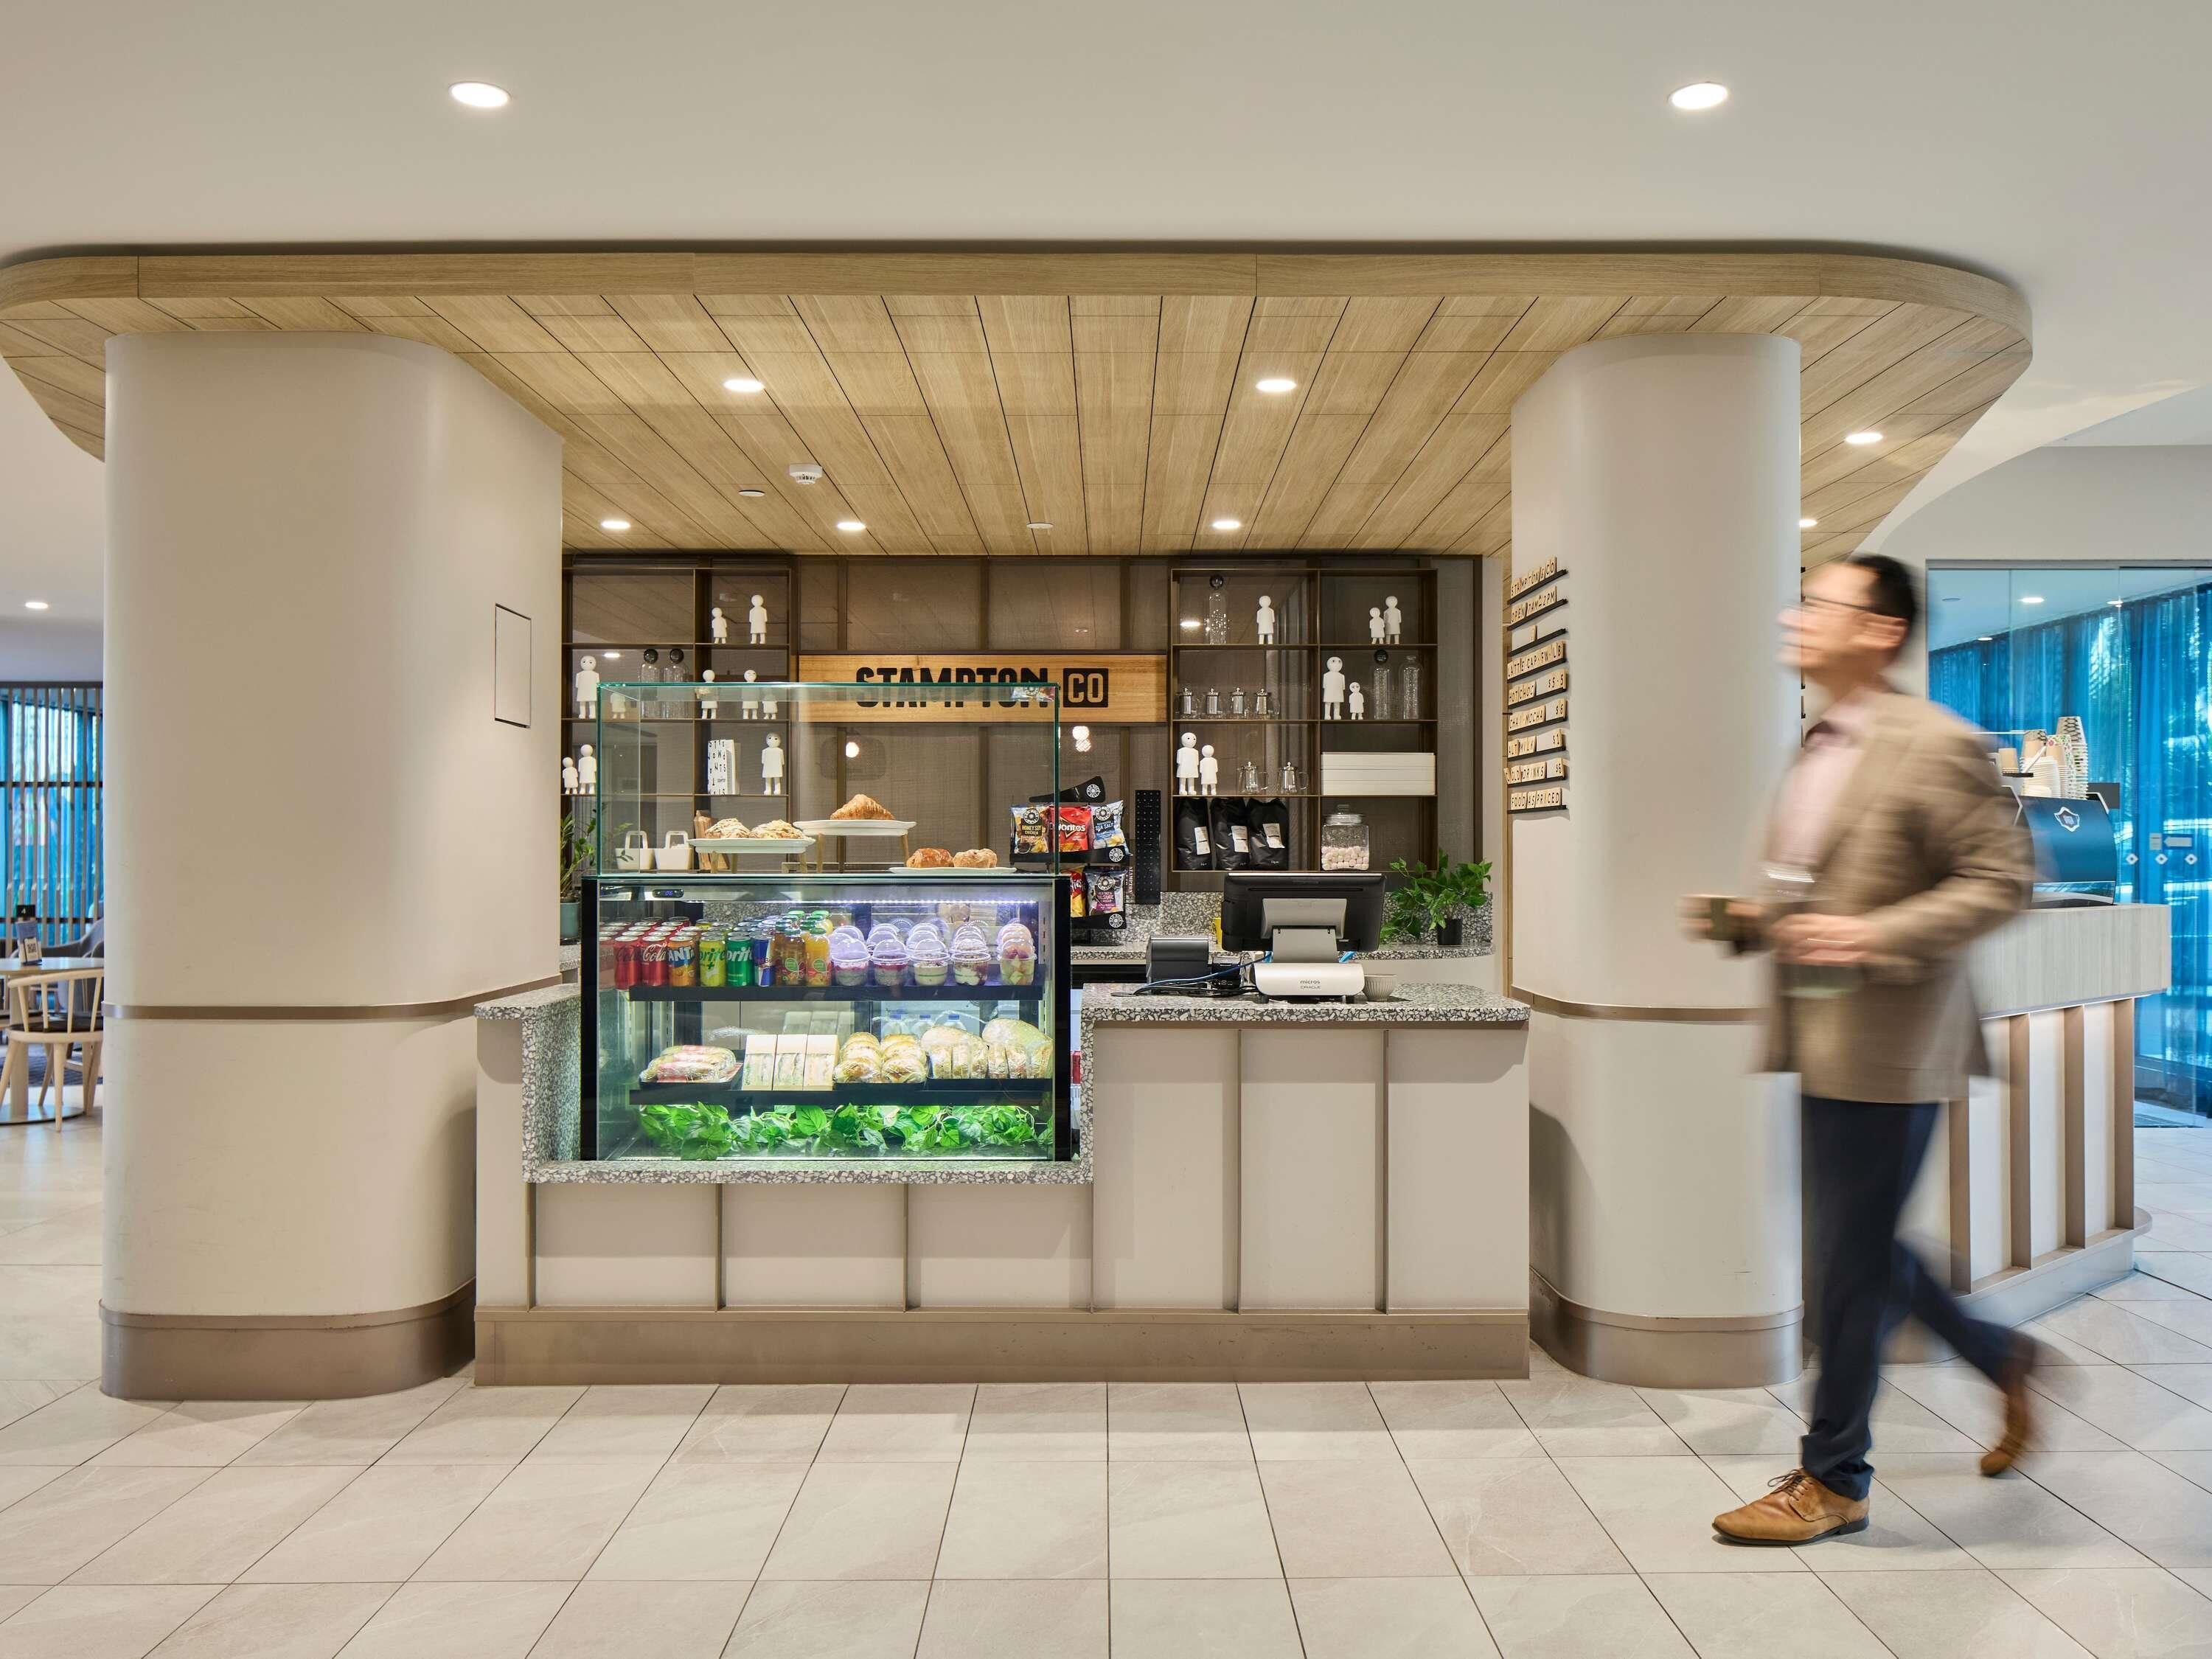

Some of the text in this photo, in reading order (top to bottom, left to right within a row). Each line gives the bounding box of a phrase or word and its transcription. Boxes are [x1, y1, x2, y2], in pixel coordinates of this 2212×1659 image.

[856, 667, 1105, 707] STAMPTON CO
[1523, 766, 1544, 779] DRINKS
[1512, 796, 1526, 807] FOOD
[1537, 792, 1559, 804] PRICED
